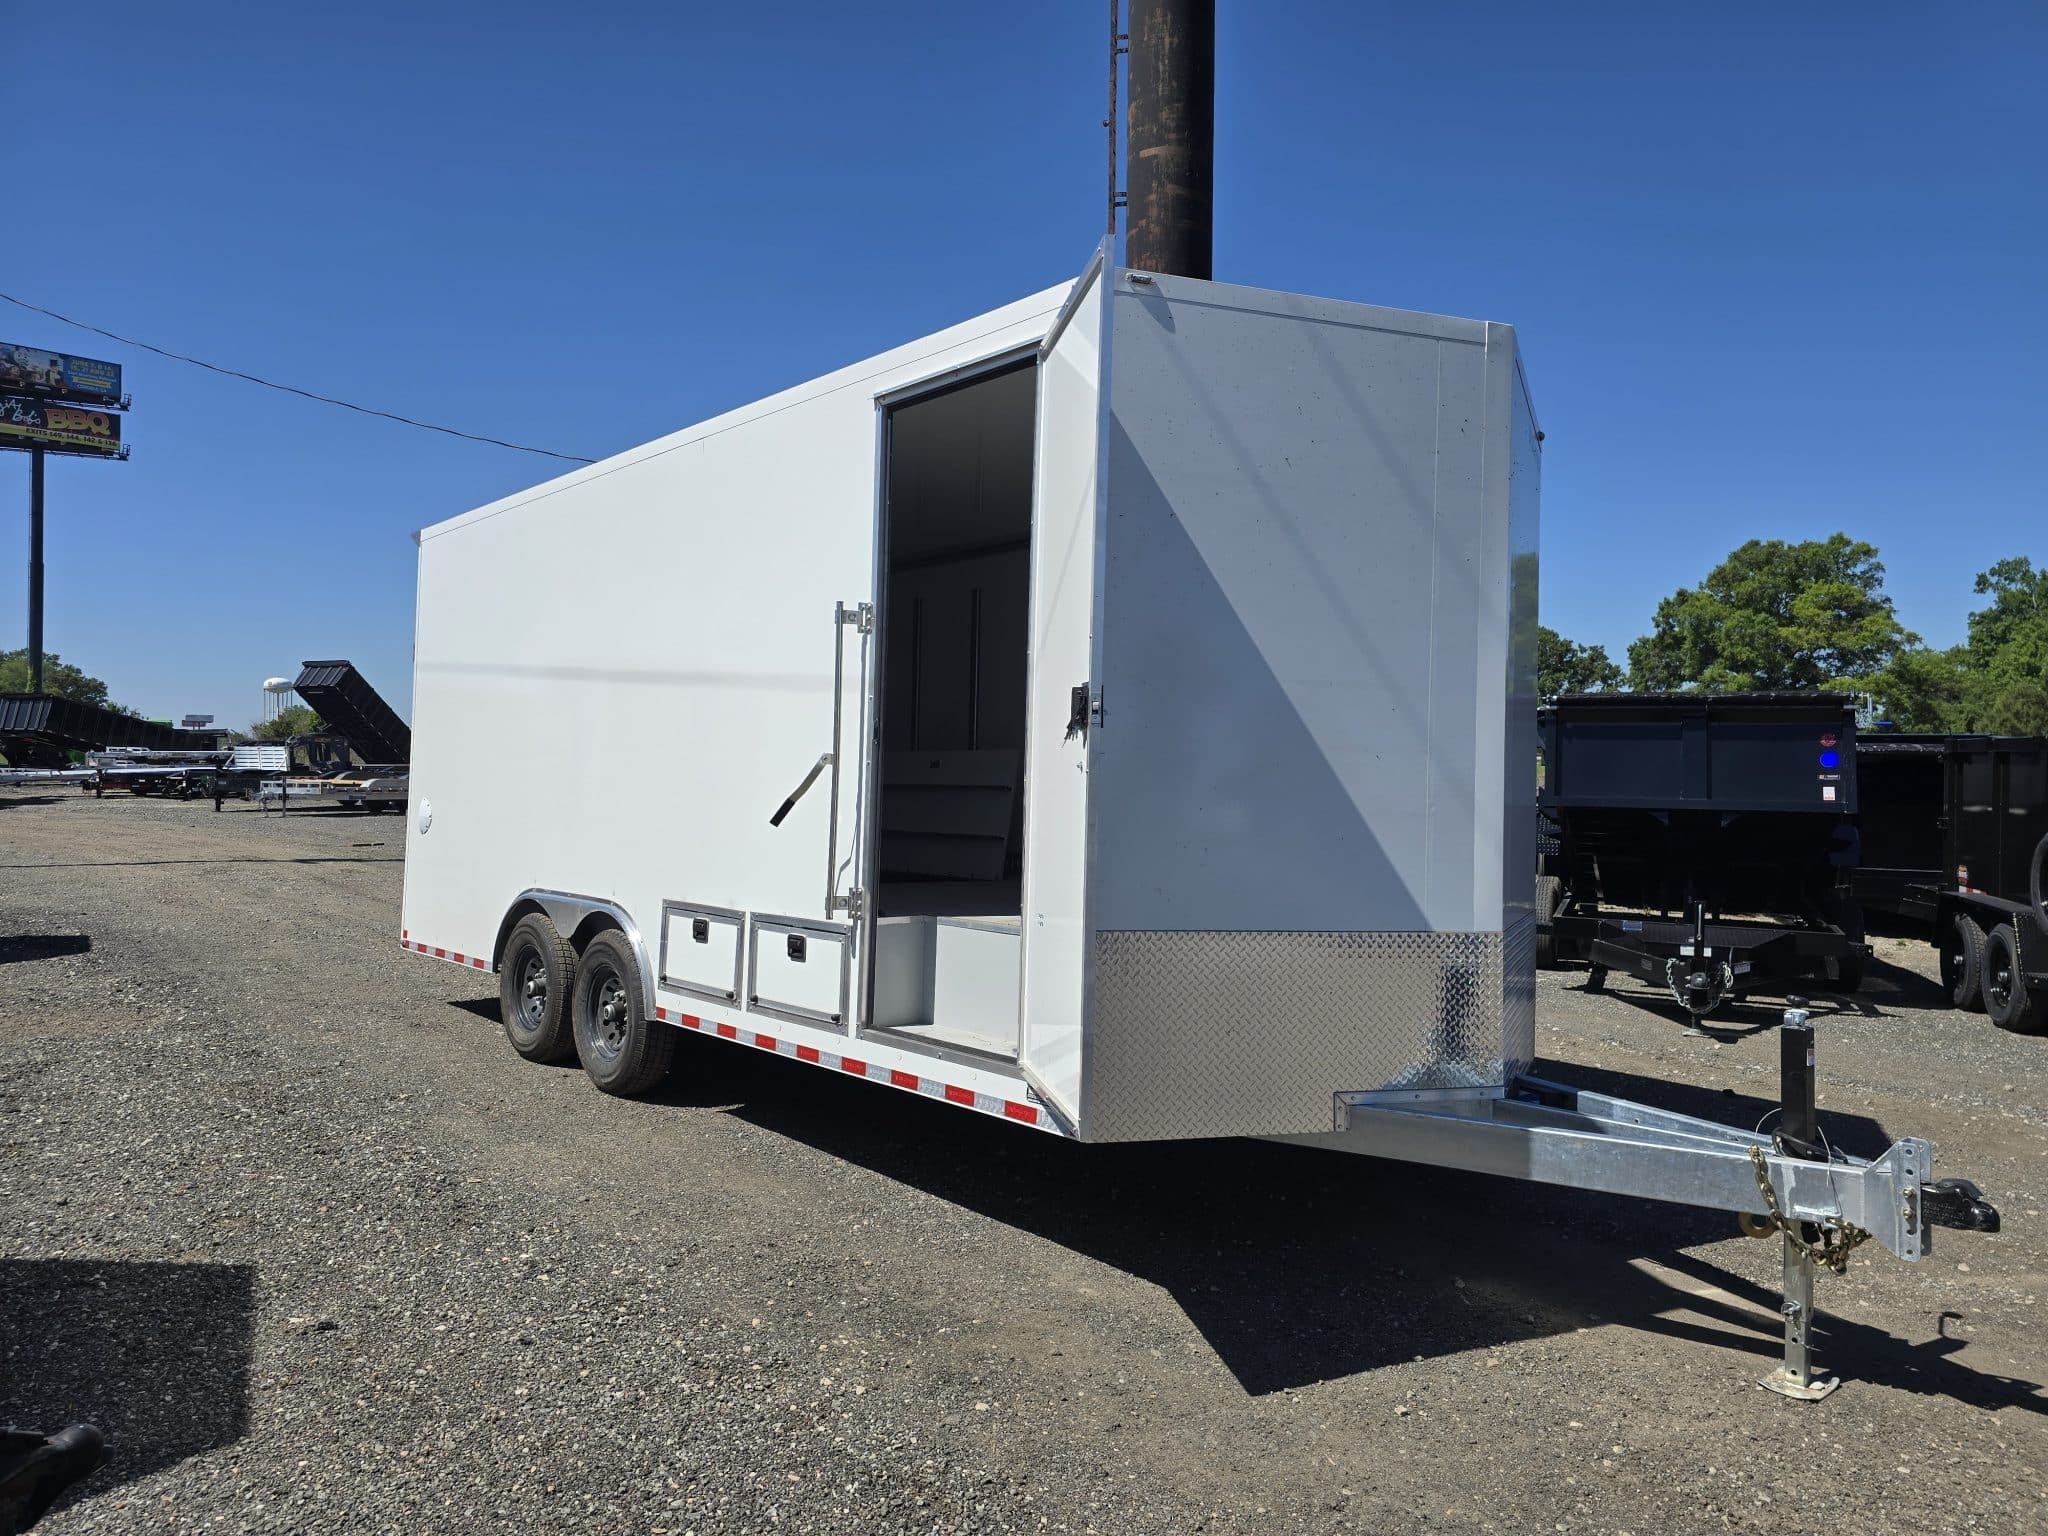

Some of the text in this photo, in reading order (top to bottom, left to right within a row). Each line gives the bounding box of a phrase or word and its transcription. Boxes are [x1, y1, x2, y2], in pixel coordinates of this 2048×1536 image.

[44, 408, 111, 435] BBQ
[26, 428, 48, 436] EXITS
[49, 431, 64, 439] 149,
